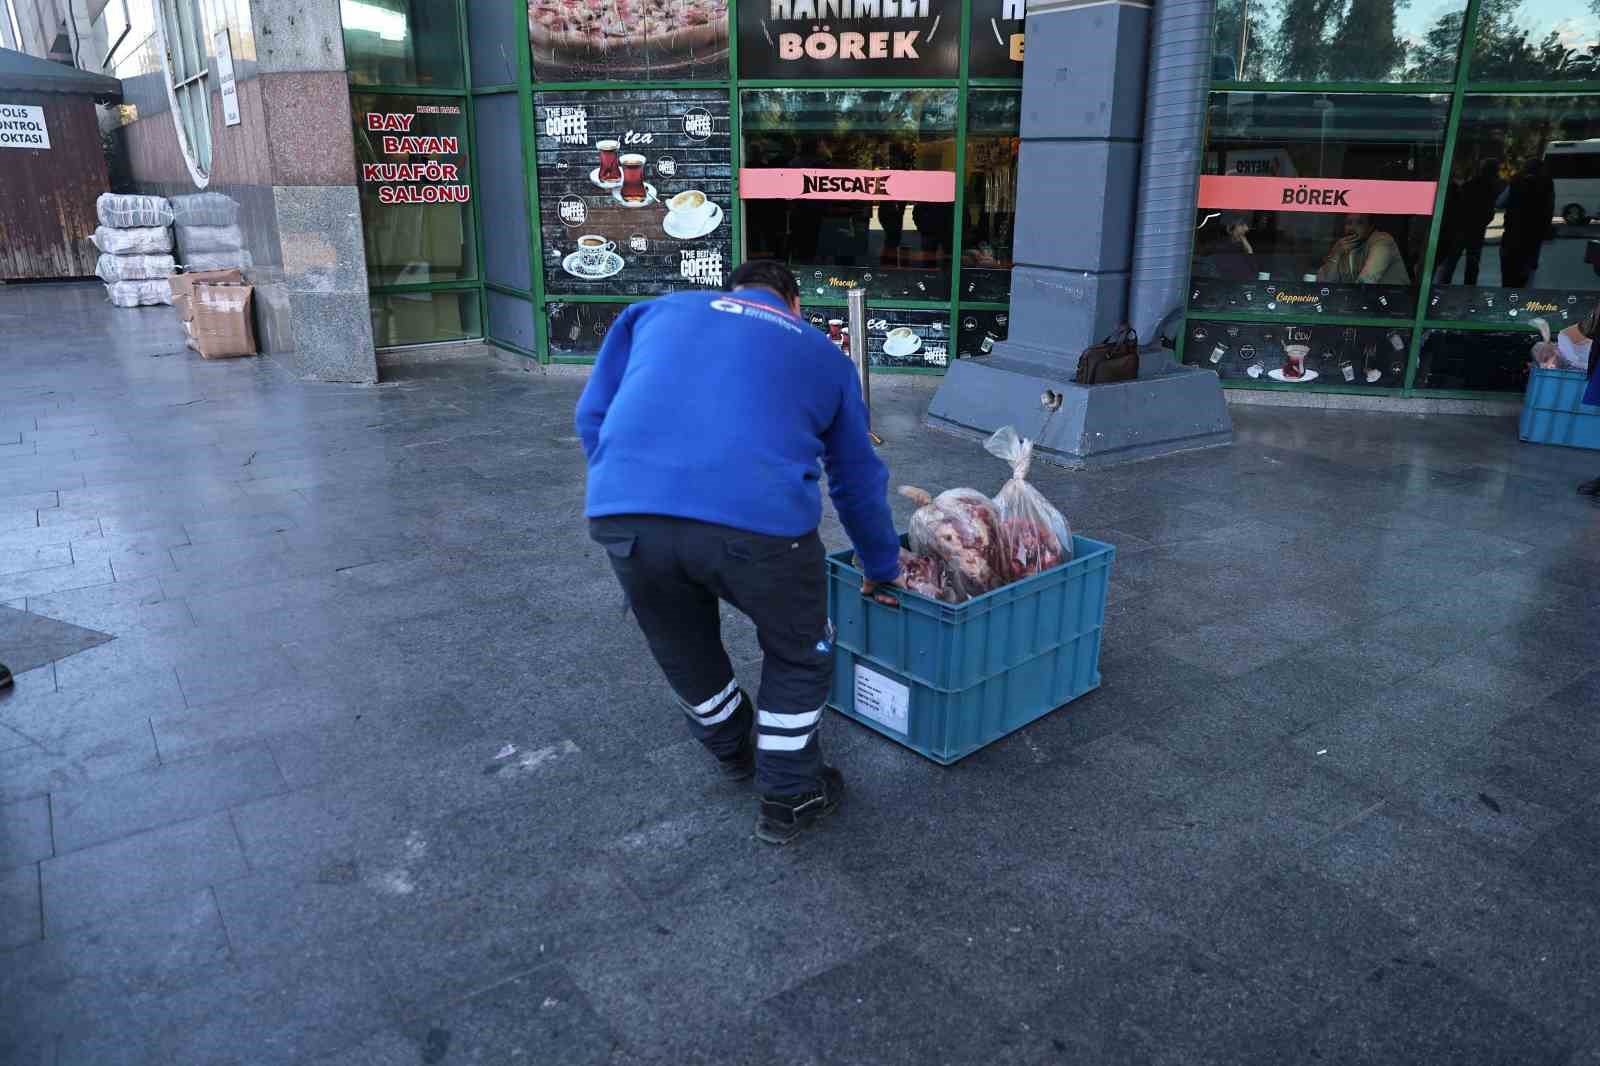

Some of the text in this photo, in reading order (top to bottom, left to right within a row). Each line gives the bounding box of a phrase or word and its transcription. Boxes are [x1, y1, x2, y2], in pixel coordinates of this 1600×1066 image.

[779, 25, 921, 60] BÖREK
[544, 107, 560, 118] THE
[0, 121, 43, 131] NTROL
[367, 113, 415, 131] BAY
[546, 115, 587, 136] COFFEE
[0, 133, 43, 143] OKTASI
[562, 134, 587, 144] TOWN
[624, 129, 654, 144] tea
[383, 136, 458, 154] BAYAN
[363, 161, 458, 182] KUAFÖR
[379, 185, 470, 203] SALONU
[1281, 185, 1352, 206] BÖREK
[680, 250, 695, 259] THE
[680, 257, 722, 277] COFFEE
[696, 275, 722, 287] TOWN
[866, 319, 888, 330] ea
